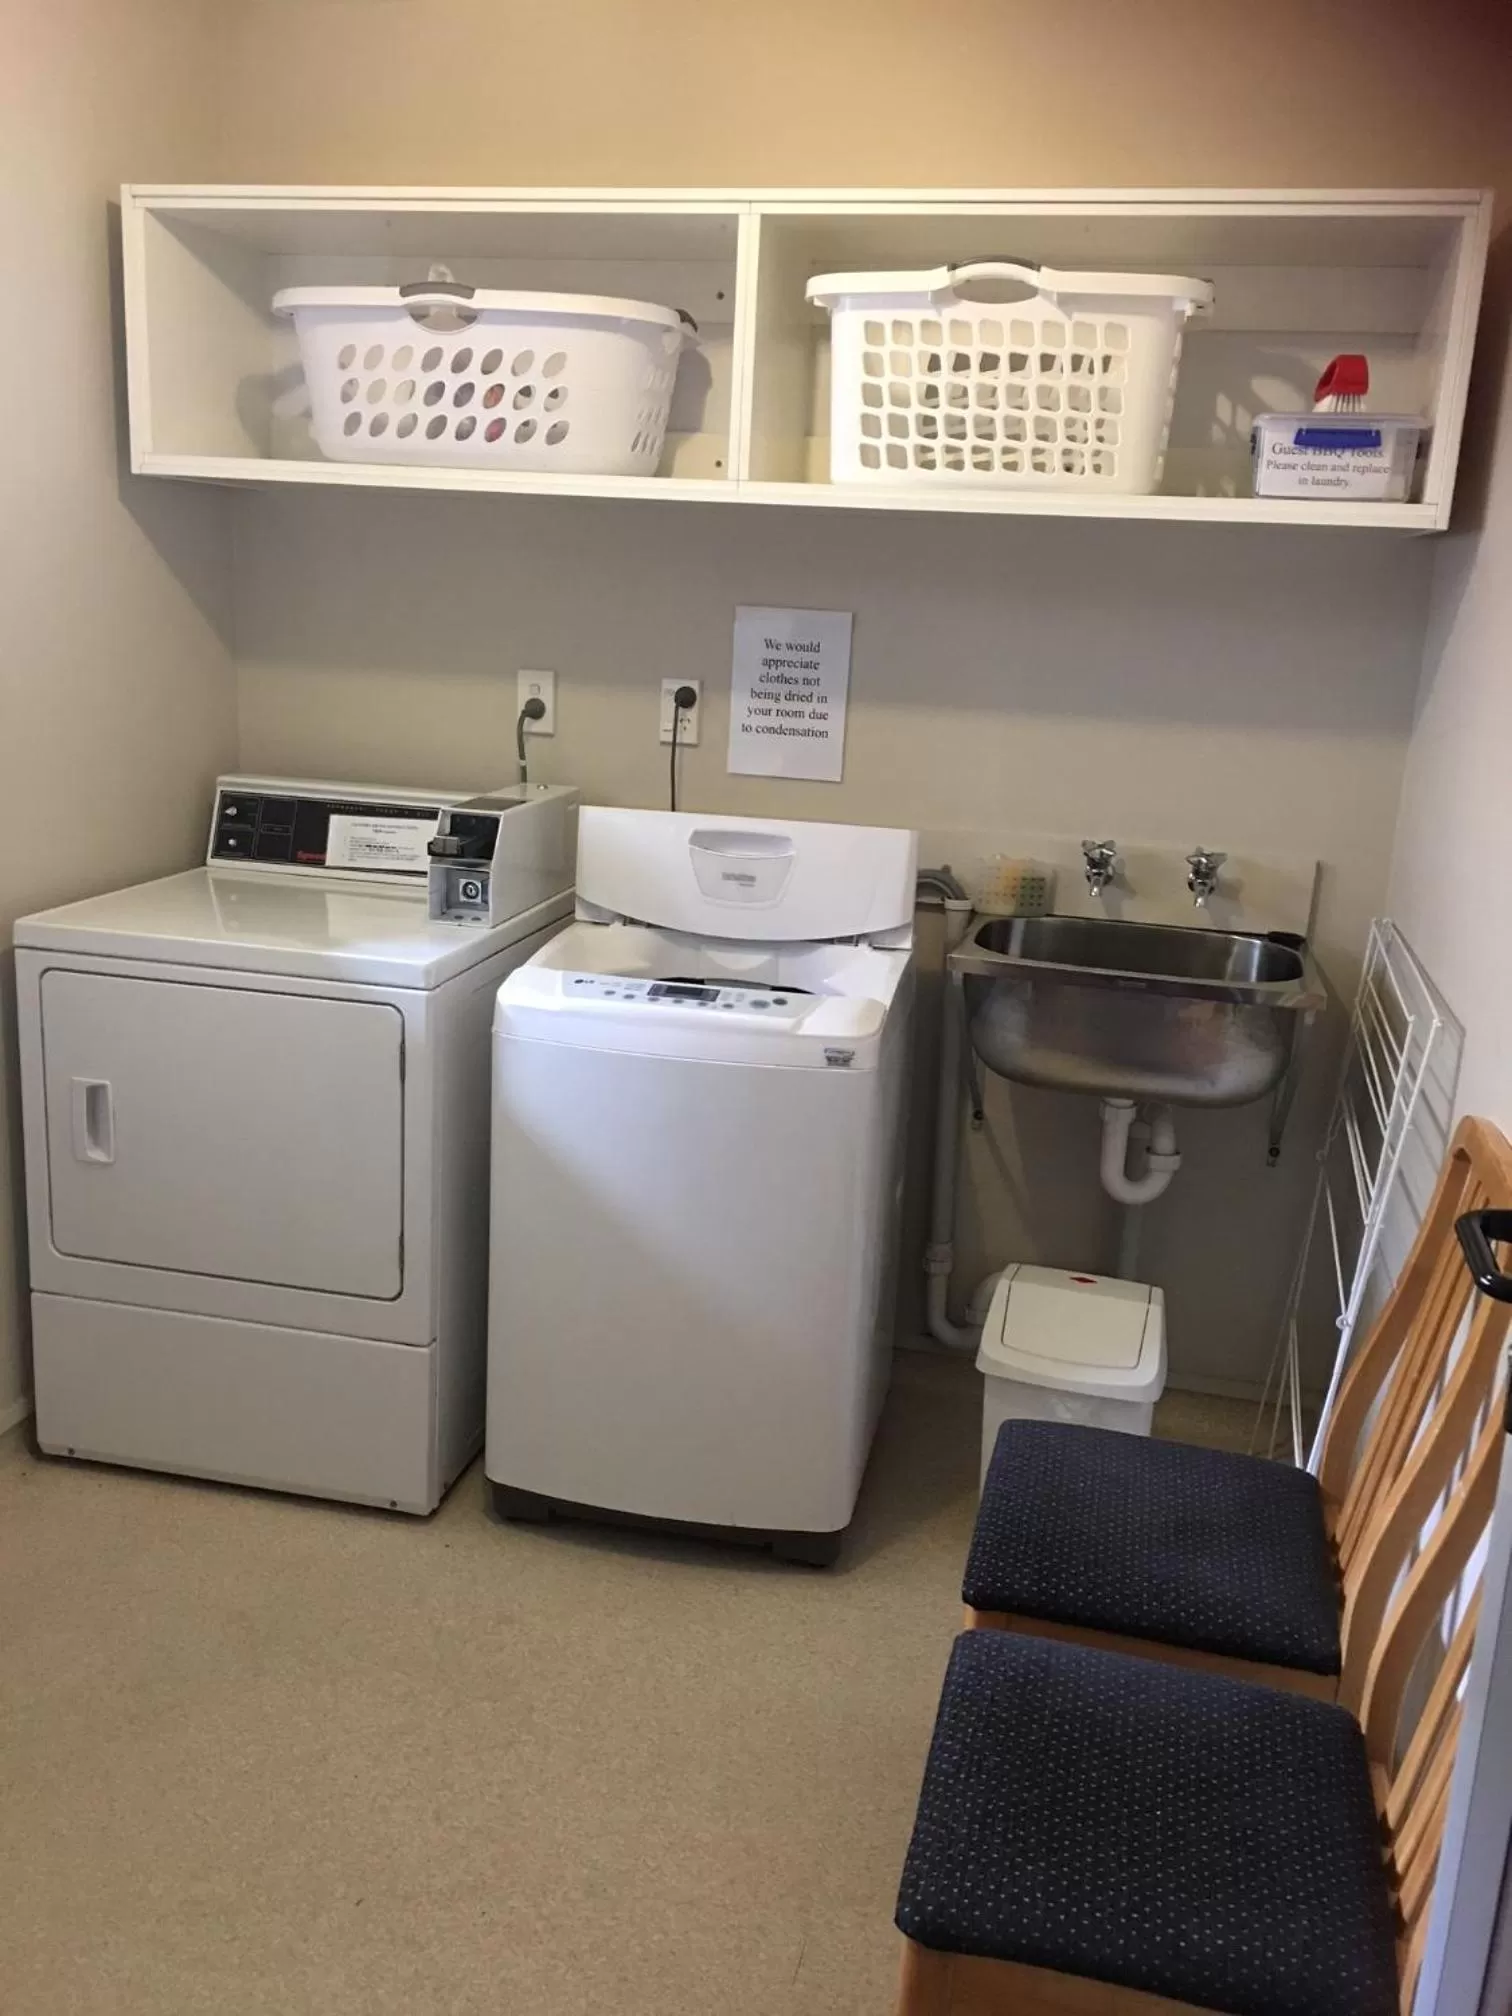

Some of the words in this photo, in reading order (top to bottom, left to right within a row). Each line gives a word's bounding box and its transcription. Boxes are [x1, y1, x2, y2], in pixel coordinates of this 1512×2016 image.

[1272, 443, 1307, 456] Guest
[1266, 460, 1299, 471] Please
[1301, 461, 1328, 472] clean
[1331, 462, 1349, 472] and
[1352, 463, 1390, 476] replace
[1298, 476, 1308, 486] in
[764, 638, 782, 651] We
[786, 641, 821, 654] would
[761, 657, 820, 671] appreciate
[759, 672, 799, 686] clothes
[802, 676, 821, 687] not
[750, 688, 782, 703] being
[784, 690, 814, 704] dried
[817, 694, 828, 704] in
[747, 706, 773, 717] your
[776, 708, 805, 719] room
[809, 709, 829, 721] due
[741, 722, 752, 733] to
[755, 723, 829, 739] condensation
